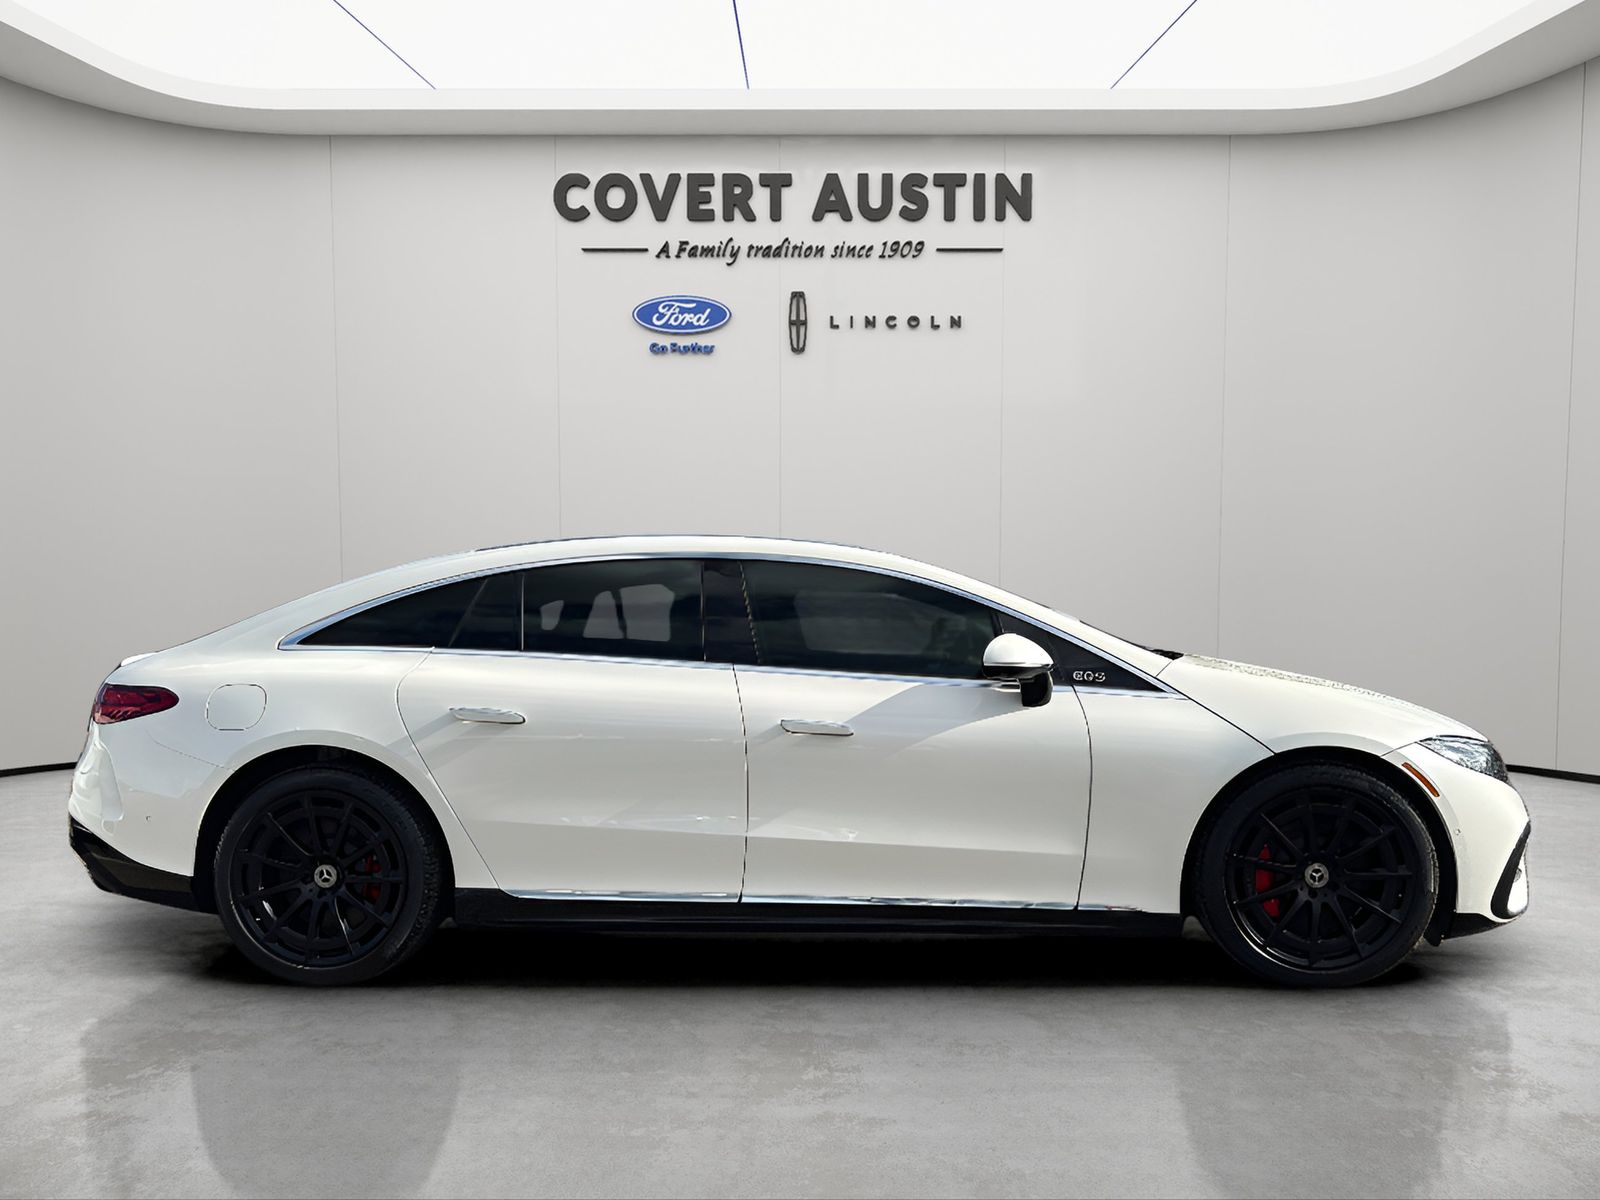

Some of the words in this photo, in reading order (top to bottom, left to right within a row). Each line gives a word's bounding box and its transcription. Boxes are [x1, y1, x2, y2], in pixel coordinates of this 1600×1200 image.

[553, 172, 793, 223] COVERT
[811, 172, 1033, 223] AUSTIN
[655, 240, 671, 259] A
[674, 236, 741, 267] Family
[746, 237, 825, 259] tradition
[830, 240, 874, 259] since
[878, 240, 925, 259] 1909
[652, 301, 711, 326] Ford
[829, 315, 962, 330] LINCOLN
